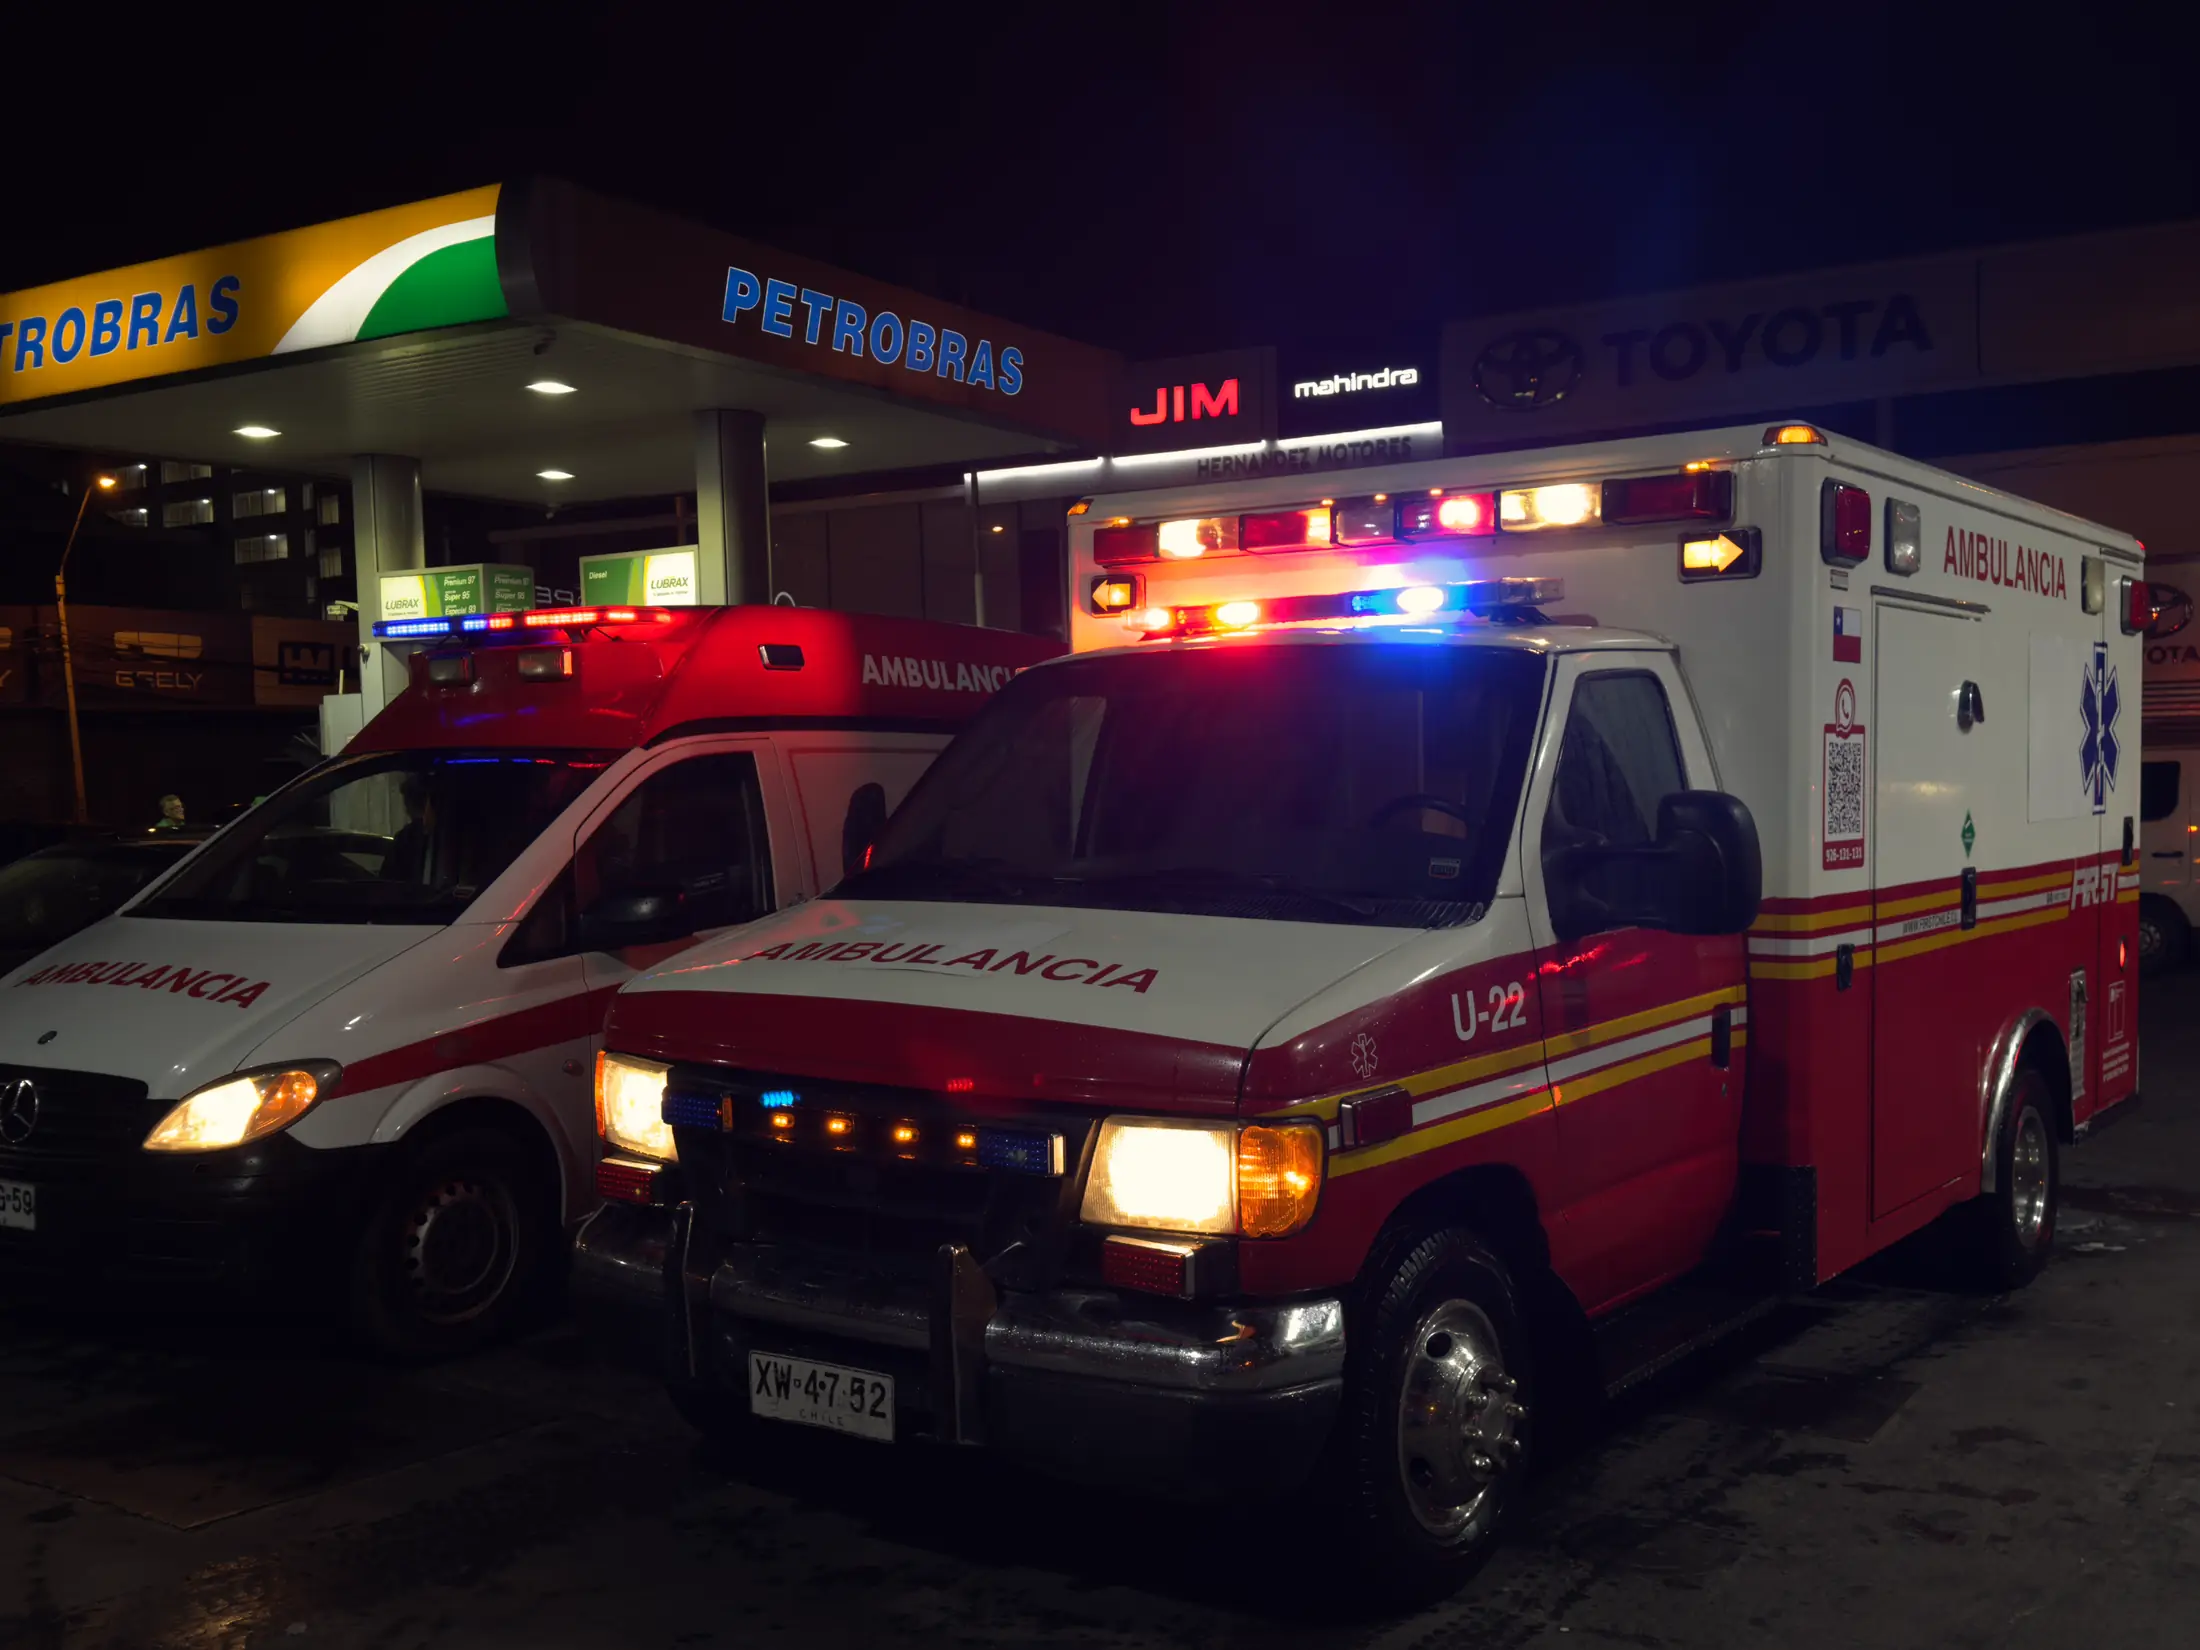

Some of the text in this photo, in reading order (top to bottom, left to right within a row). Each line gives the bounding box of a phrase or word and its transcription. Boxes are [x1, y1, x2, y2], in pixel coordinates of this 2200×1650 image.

[721, 266, 1024, 396] PETROBRAS
[1603, 293, 1934, 388] TOYOTA
[1294, 367, 1419, 399] mahindra
[1130, 378, 1240, 427] JIM
[1197, 436, 1412, 478] HERNANDEZ MOTORES
[443, 575, 476, 586] Premium 97
[588, 570, 608, 580] Diesel
[1943, 526, 2067, 600] AMBULANCIA
[444, 593, 461, 602] Super
[651, 577, 689, 589] LUBRAX
[385, 598, 420, 610] LUBRAX
[2144, 645, 2200, 666] OTA
[14, 961, 271, 1009] AMBULANCIA
[744, 942, 1160, 994] AMBULANCIA
[1451, 981, 1527, 1041] U-22
[799, 1409, 844, 1427] CHILE
